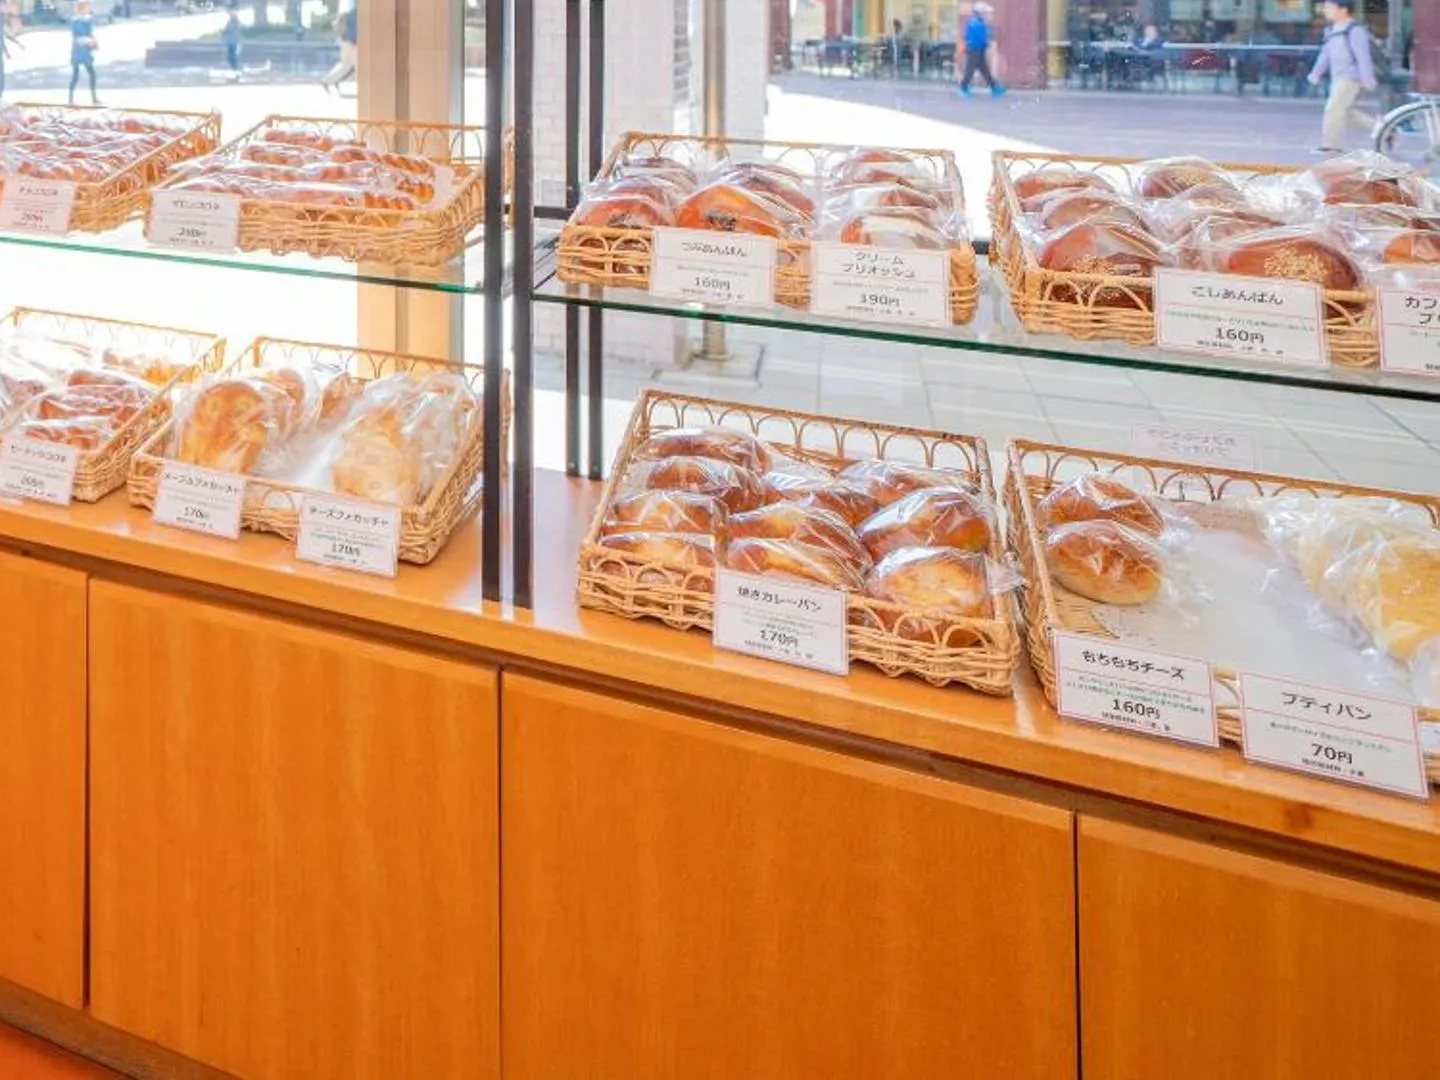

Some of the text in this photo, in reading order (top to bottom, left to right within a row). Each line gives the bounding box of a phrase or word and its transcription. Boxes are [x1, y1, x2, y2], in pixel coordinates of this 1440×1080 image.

[1191, 285, 1284, 306] こしあんぱん
[1215, 327, 1265, 344] 160円
[737, 586, 822, 613] 焼きカレーパン
[759, 629, 799, 648] 170円
[1081, 649, 1185, 680] もちもちチーズ
[1112, 698, 1161, 720] 160円
[1310, 742, 1354, 765] 70円
